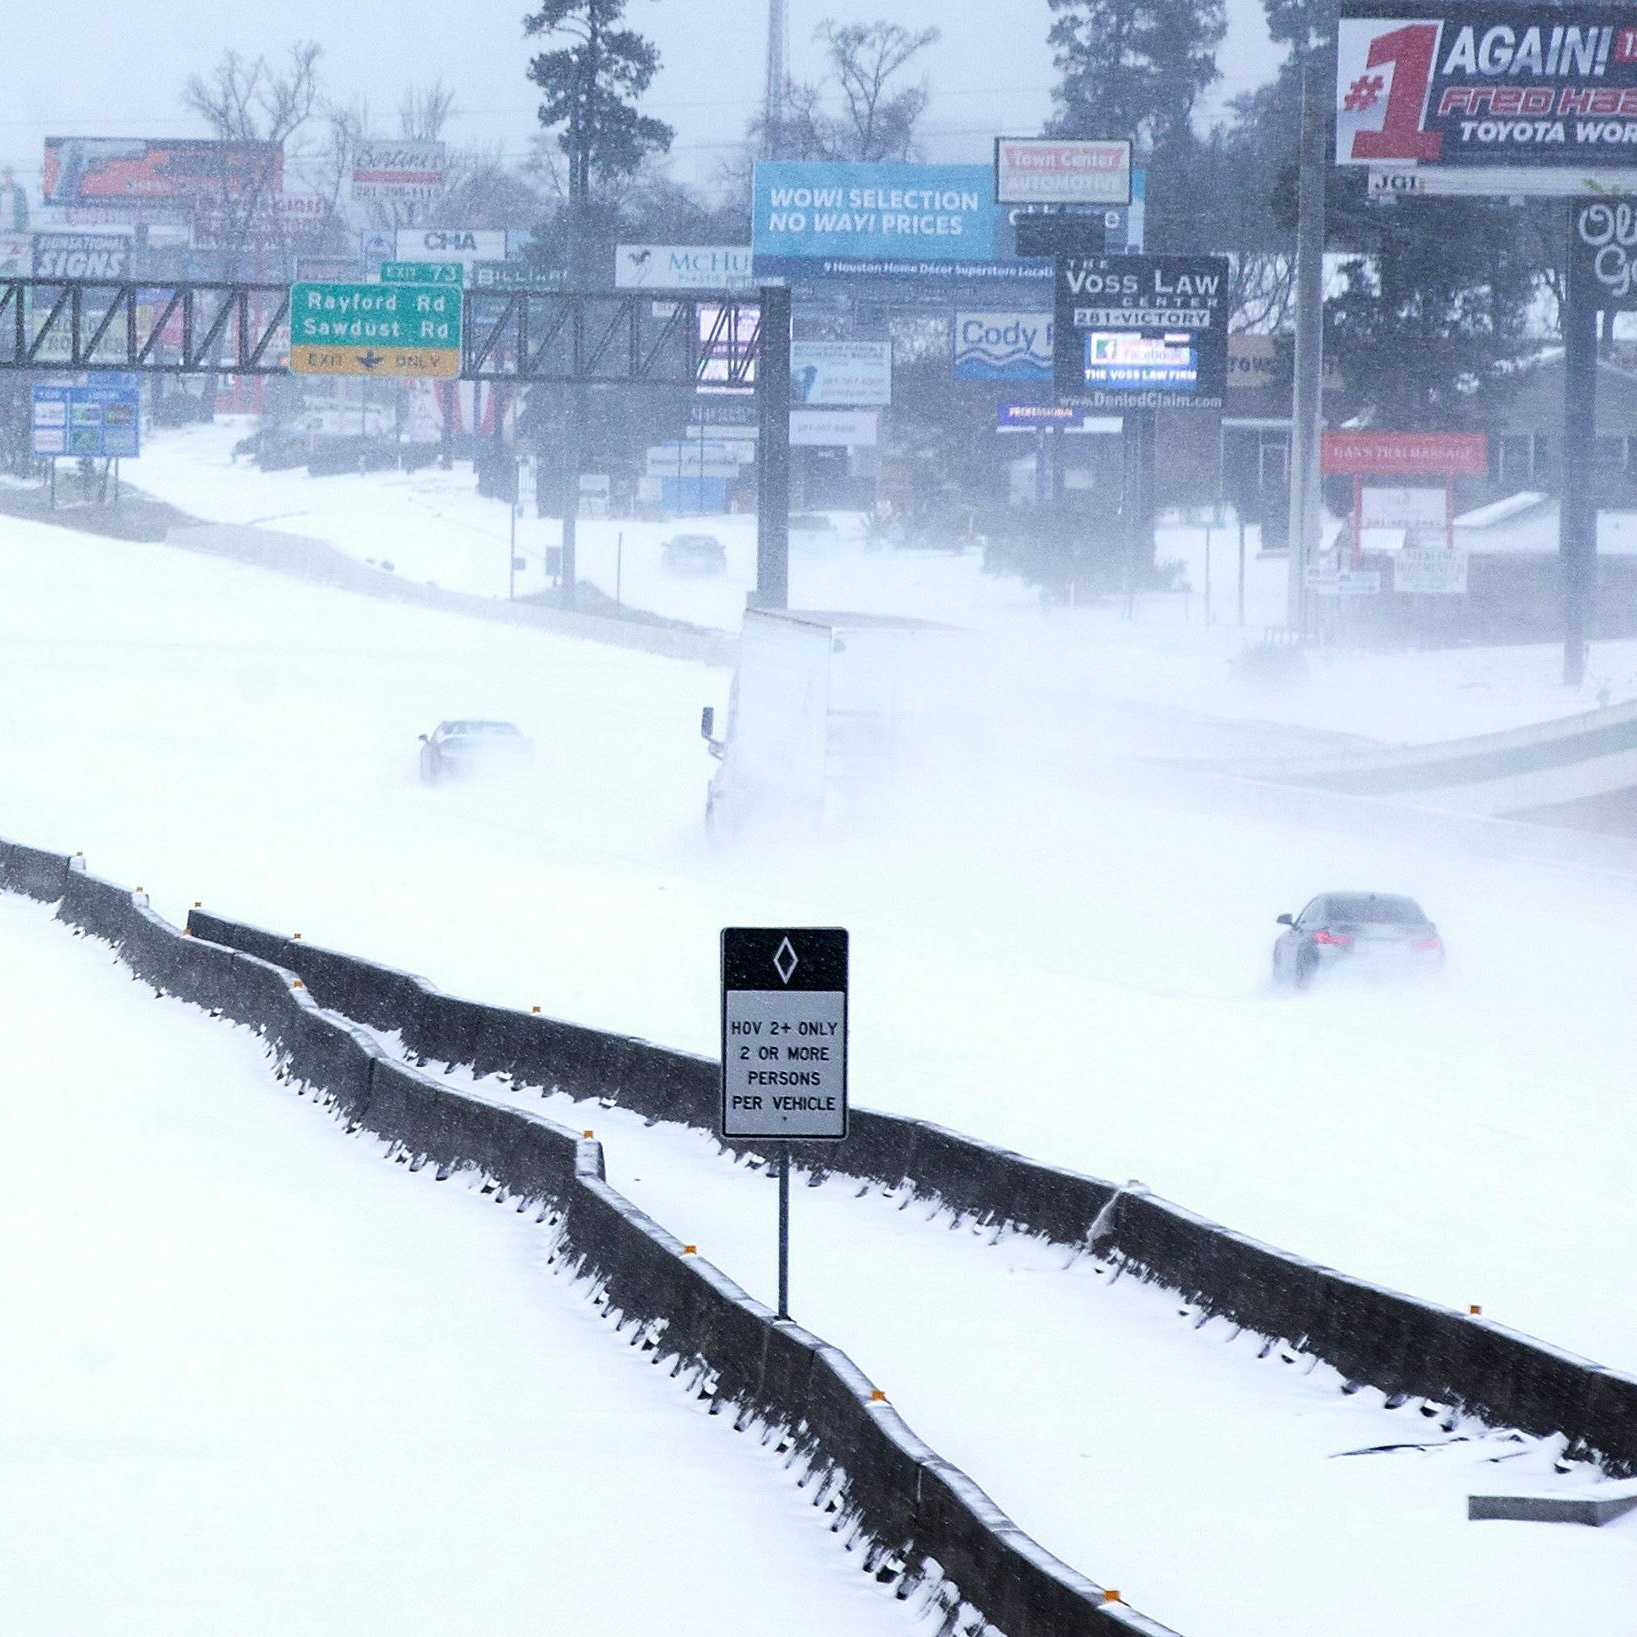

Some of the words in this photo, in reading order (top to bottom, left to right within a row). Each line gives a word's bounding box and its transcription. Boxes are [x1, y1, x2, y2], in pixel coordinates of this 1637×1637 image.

[1442, 26, 1613, 76] AGAIN!
[1460, 121, 1566, 143] TOYOTA
[1014, 151, 1055, 167] Town
[1060, 151, 1114, 168] Center
[769, 188, 843, 209] WOW!
[849, 189, 980, 212] SELECTION
[769, 212, 807, 233] NO
[813, 213, 875, 233] WAY!
[882, 214, 964, 235] PRICES
[38, 251, 126, 278] SIGNS
[833, 261, 882, 274] Houston
[884, 262, 917, 274] Home
[1067, 259, 1109, 269] THE
[386, 266, 416, 279] EXIT
[430, 265, 456, 281] 73
[308, 292, 397, 313] Rayford
[416, 295, 446, 312] Rd
[1122, 297, 1218, 307] CENTER
[1076, 311, 1208, 325] 281-VICTORY
[303, 318, 401, 337] Sawdust
[421, 320, 449, 339] Rd
[964, 320, 1037, 350] Cody
[307, 353, 344, 367] EXIT
[395, 354, 441, 368] ONLY
[1084, 369, 1107, 381] THE
[1110, 369, 1140, 381] VOSS
[1142, 369, 1167, 381] LAW
[1168, 370, 1198, 381] FIRM
[731, 1021, 762, 1036] HOV
[770, 1021, 791, 1036] 2+
[798, 1021, 838, 1036] ONLY
[740, 1046, 750, 1061] 2
[758, 1046, 779, 1061] OR
[788, 1046, 829, 1061] MORE
[748, 1071, 821, 1086] PERSONS
[732, 1095, 763, 1110] PER
[773, 1096, 836, 1111] VEHICLE
